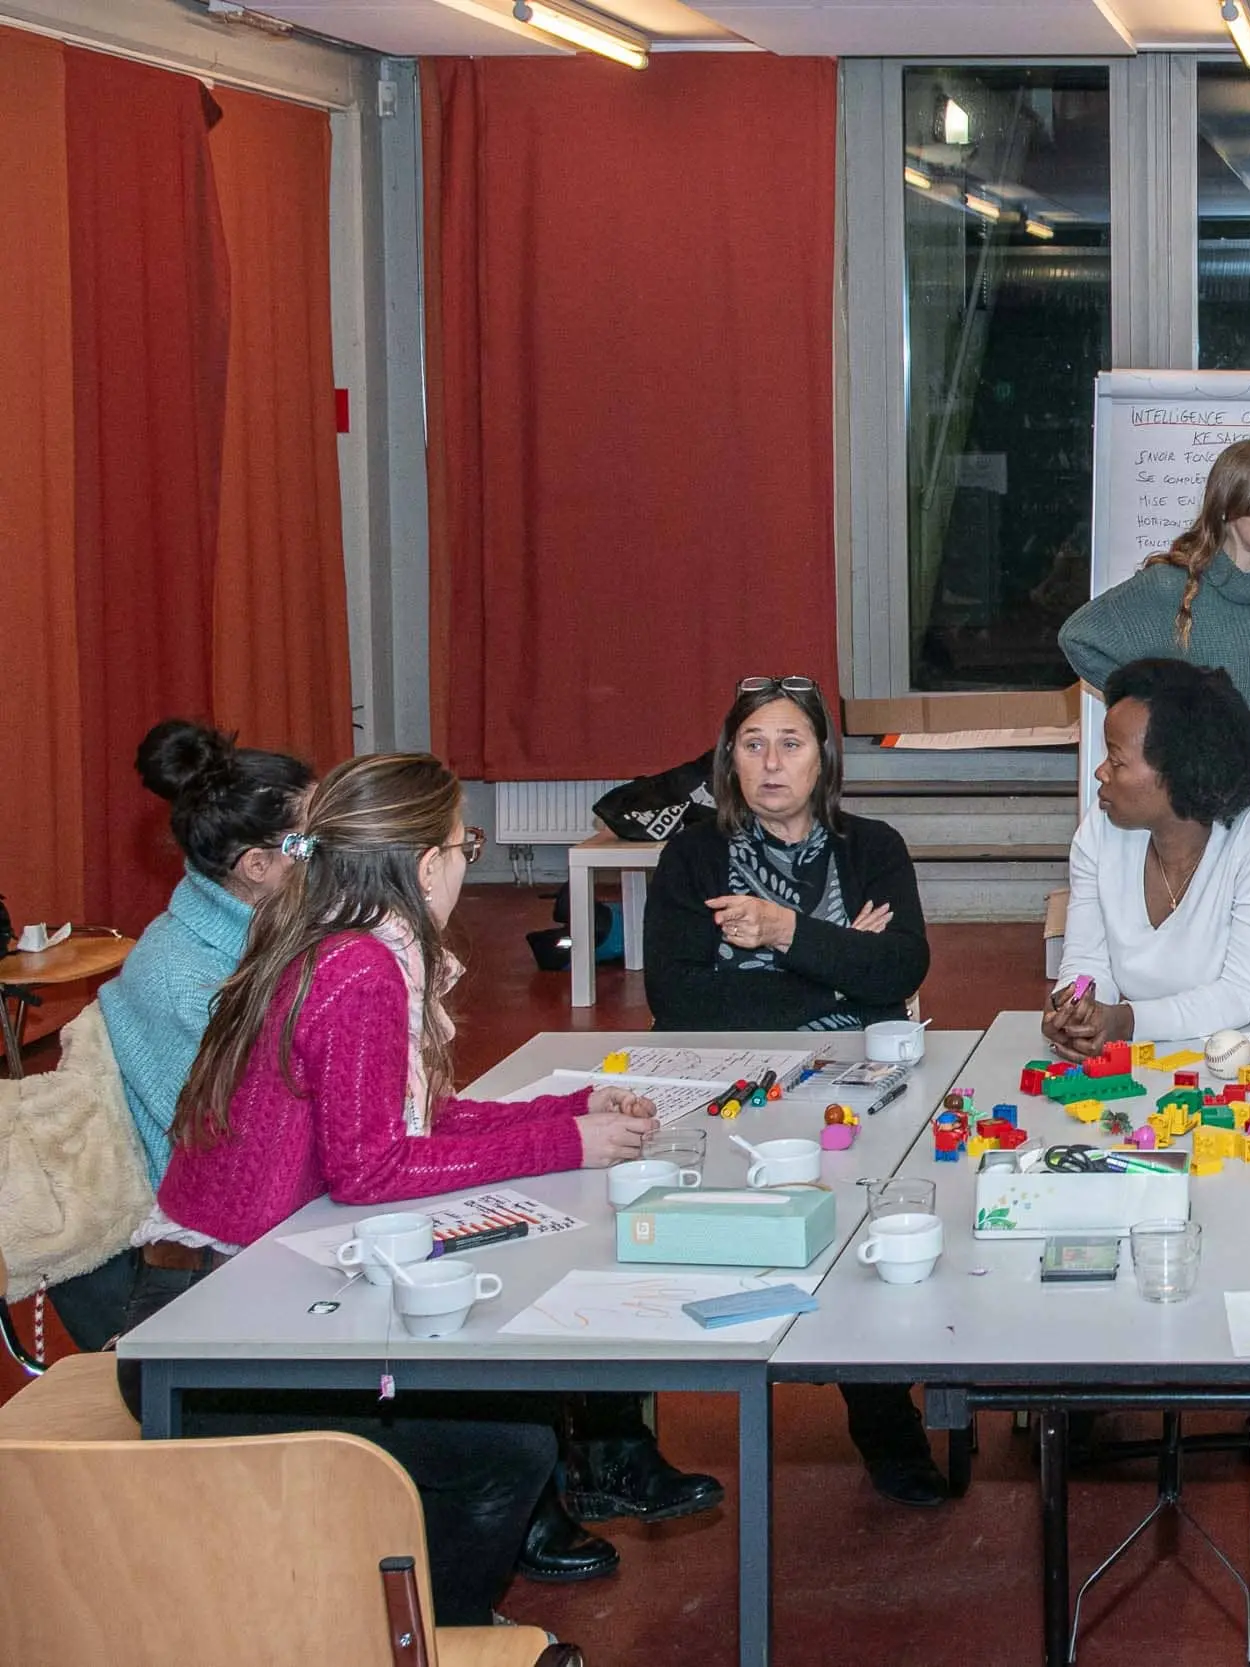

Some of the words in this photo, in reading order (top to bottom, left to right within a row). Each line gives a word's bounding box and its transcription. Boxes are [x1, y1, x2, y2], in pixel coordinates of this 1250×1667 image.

[1131, 405, 1229, 426] INTELLIGENCE
[1135, 449, 1176, 465] SAVOIR
[1139, 494, 1169, 508] MISE
